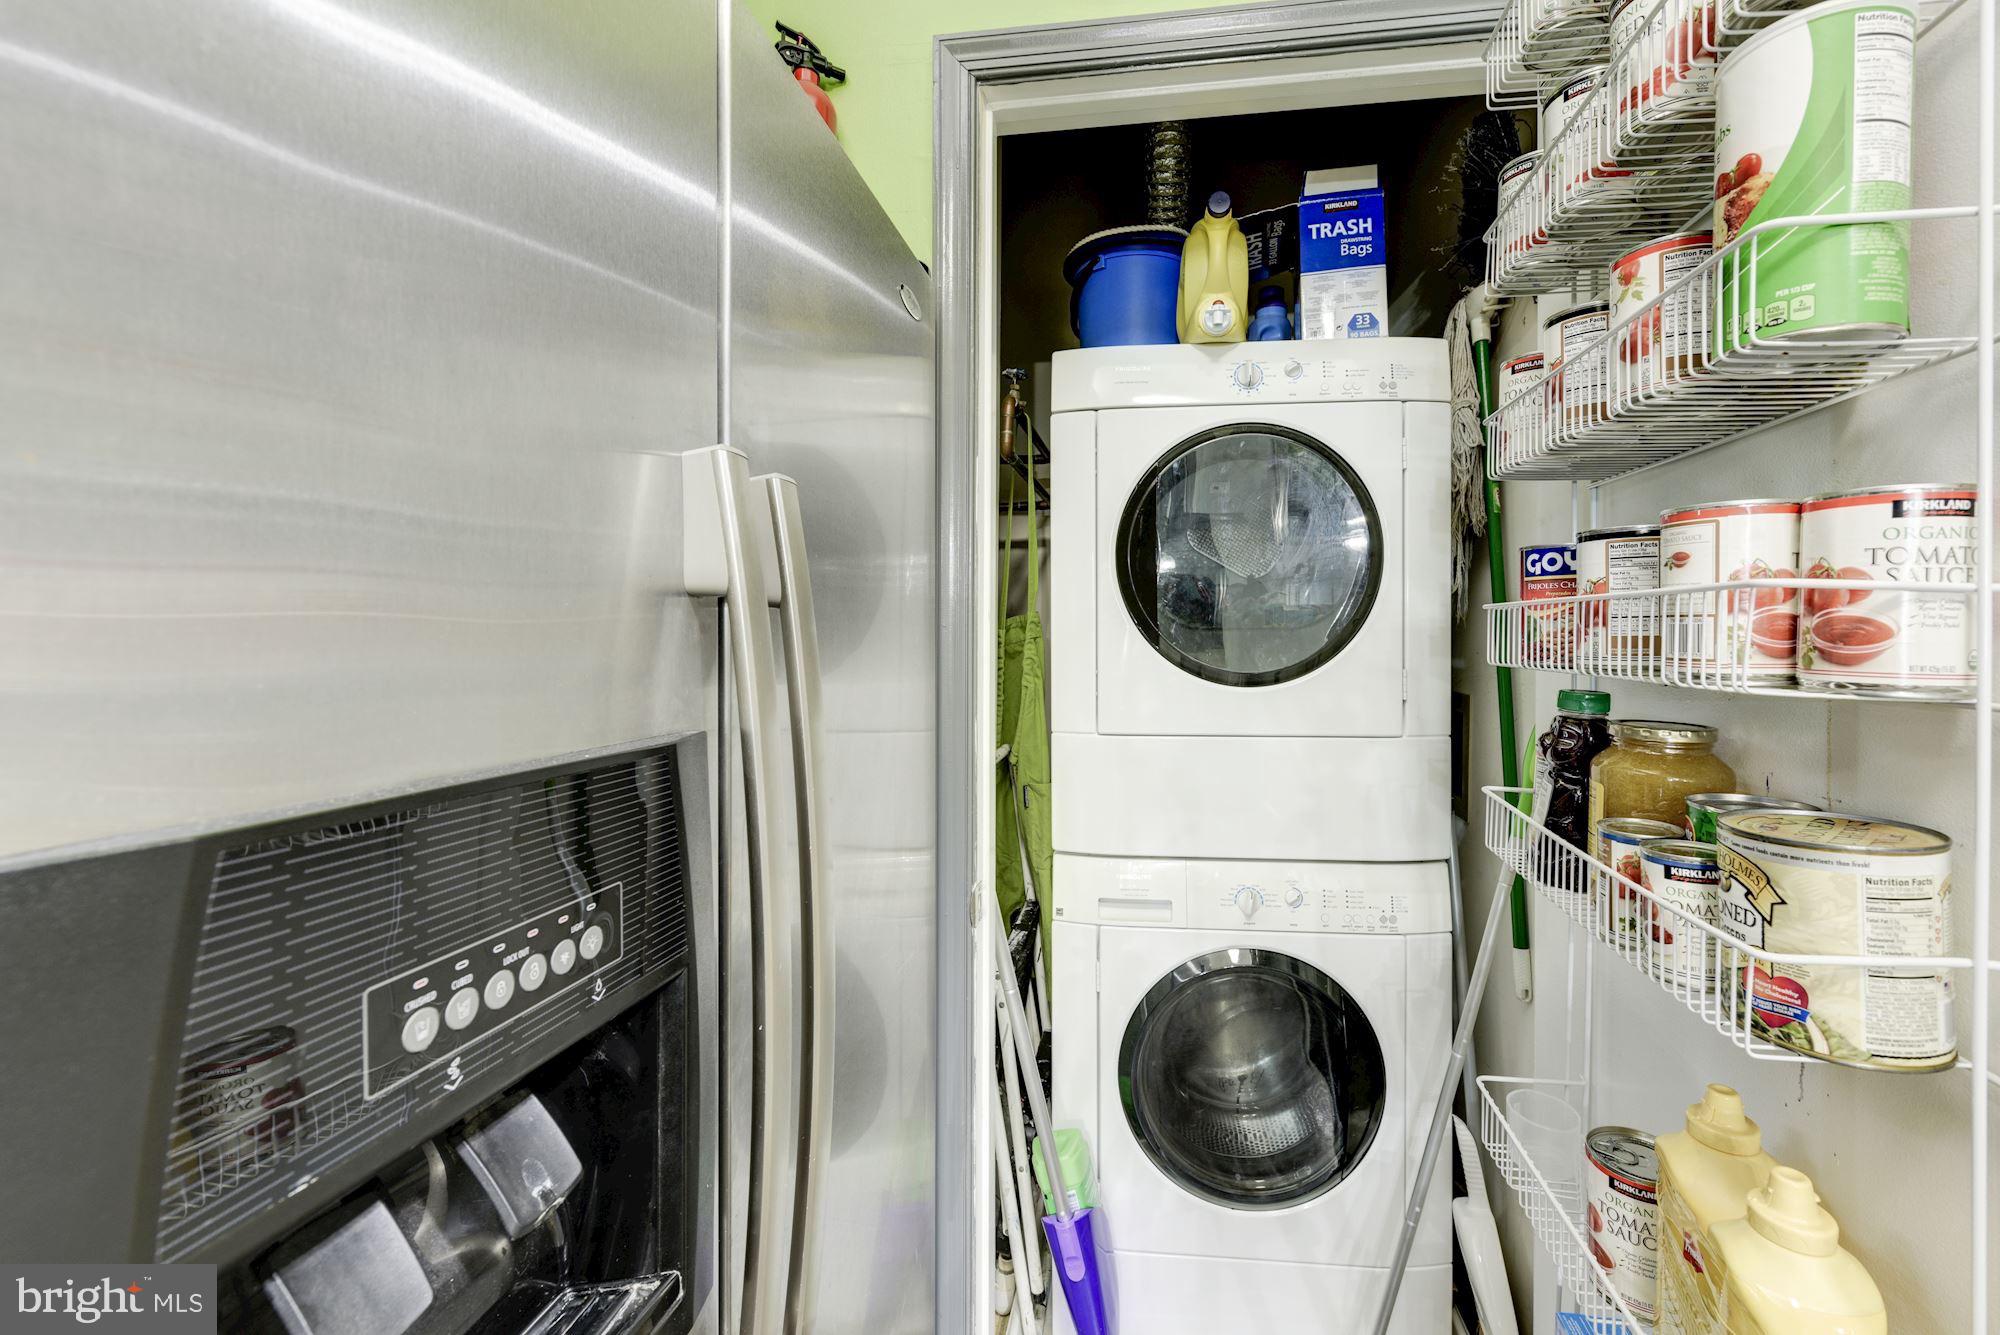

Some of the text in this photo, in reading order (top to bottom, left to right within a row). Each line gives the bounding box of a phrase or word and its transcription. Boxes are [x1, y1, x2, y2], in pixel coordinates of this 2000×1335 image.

[1325, 200, 1358, 210] KIRKLAND
[1308, 218, 1372, 240] TRASH
[1341, 244, 1372, 257] Bags
[1665, 250, 1697, 261] Nutrition
[1355, 314, 1370, 325] 33
[1514, 359, 1543, 370] KIRKLAN
[1671, 866, 1719, 879] KIRKLAN
[1866, 877, 1910, 886] Nutrition
